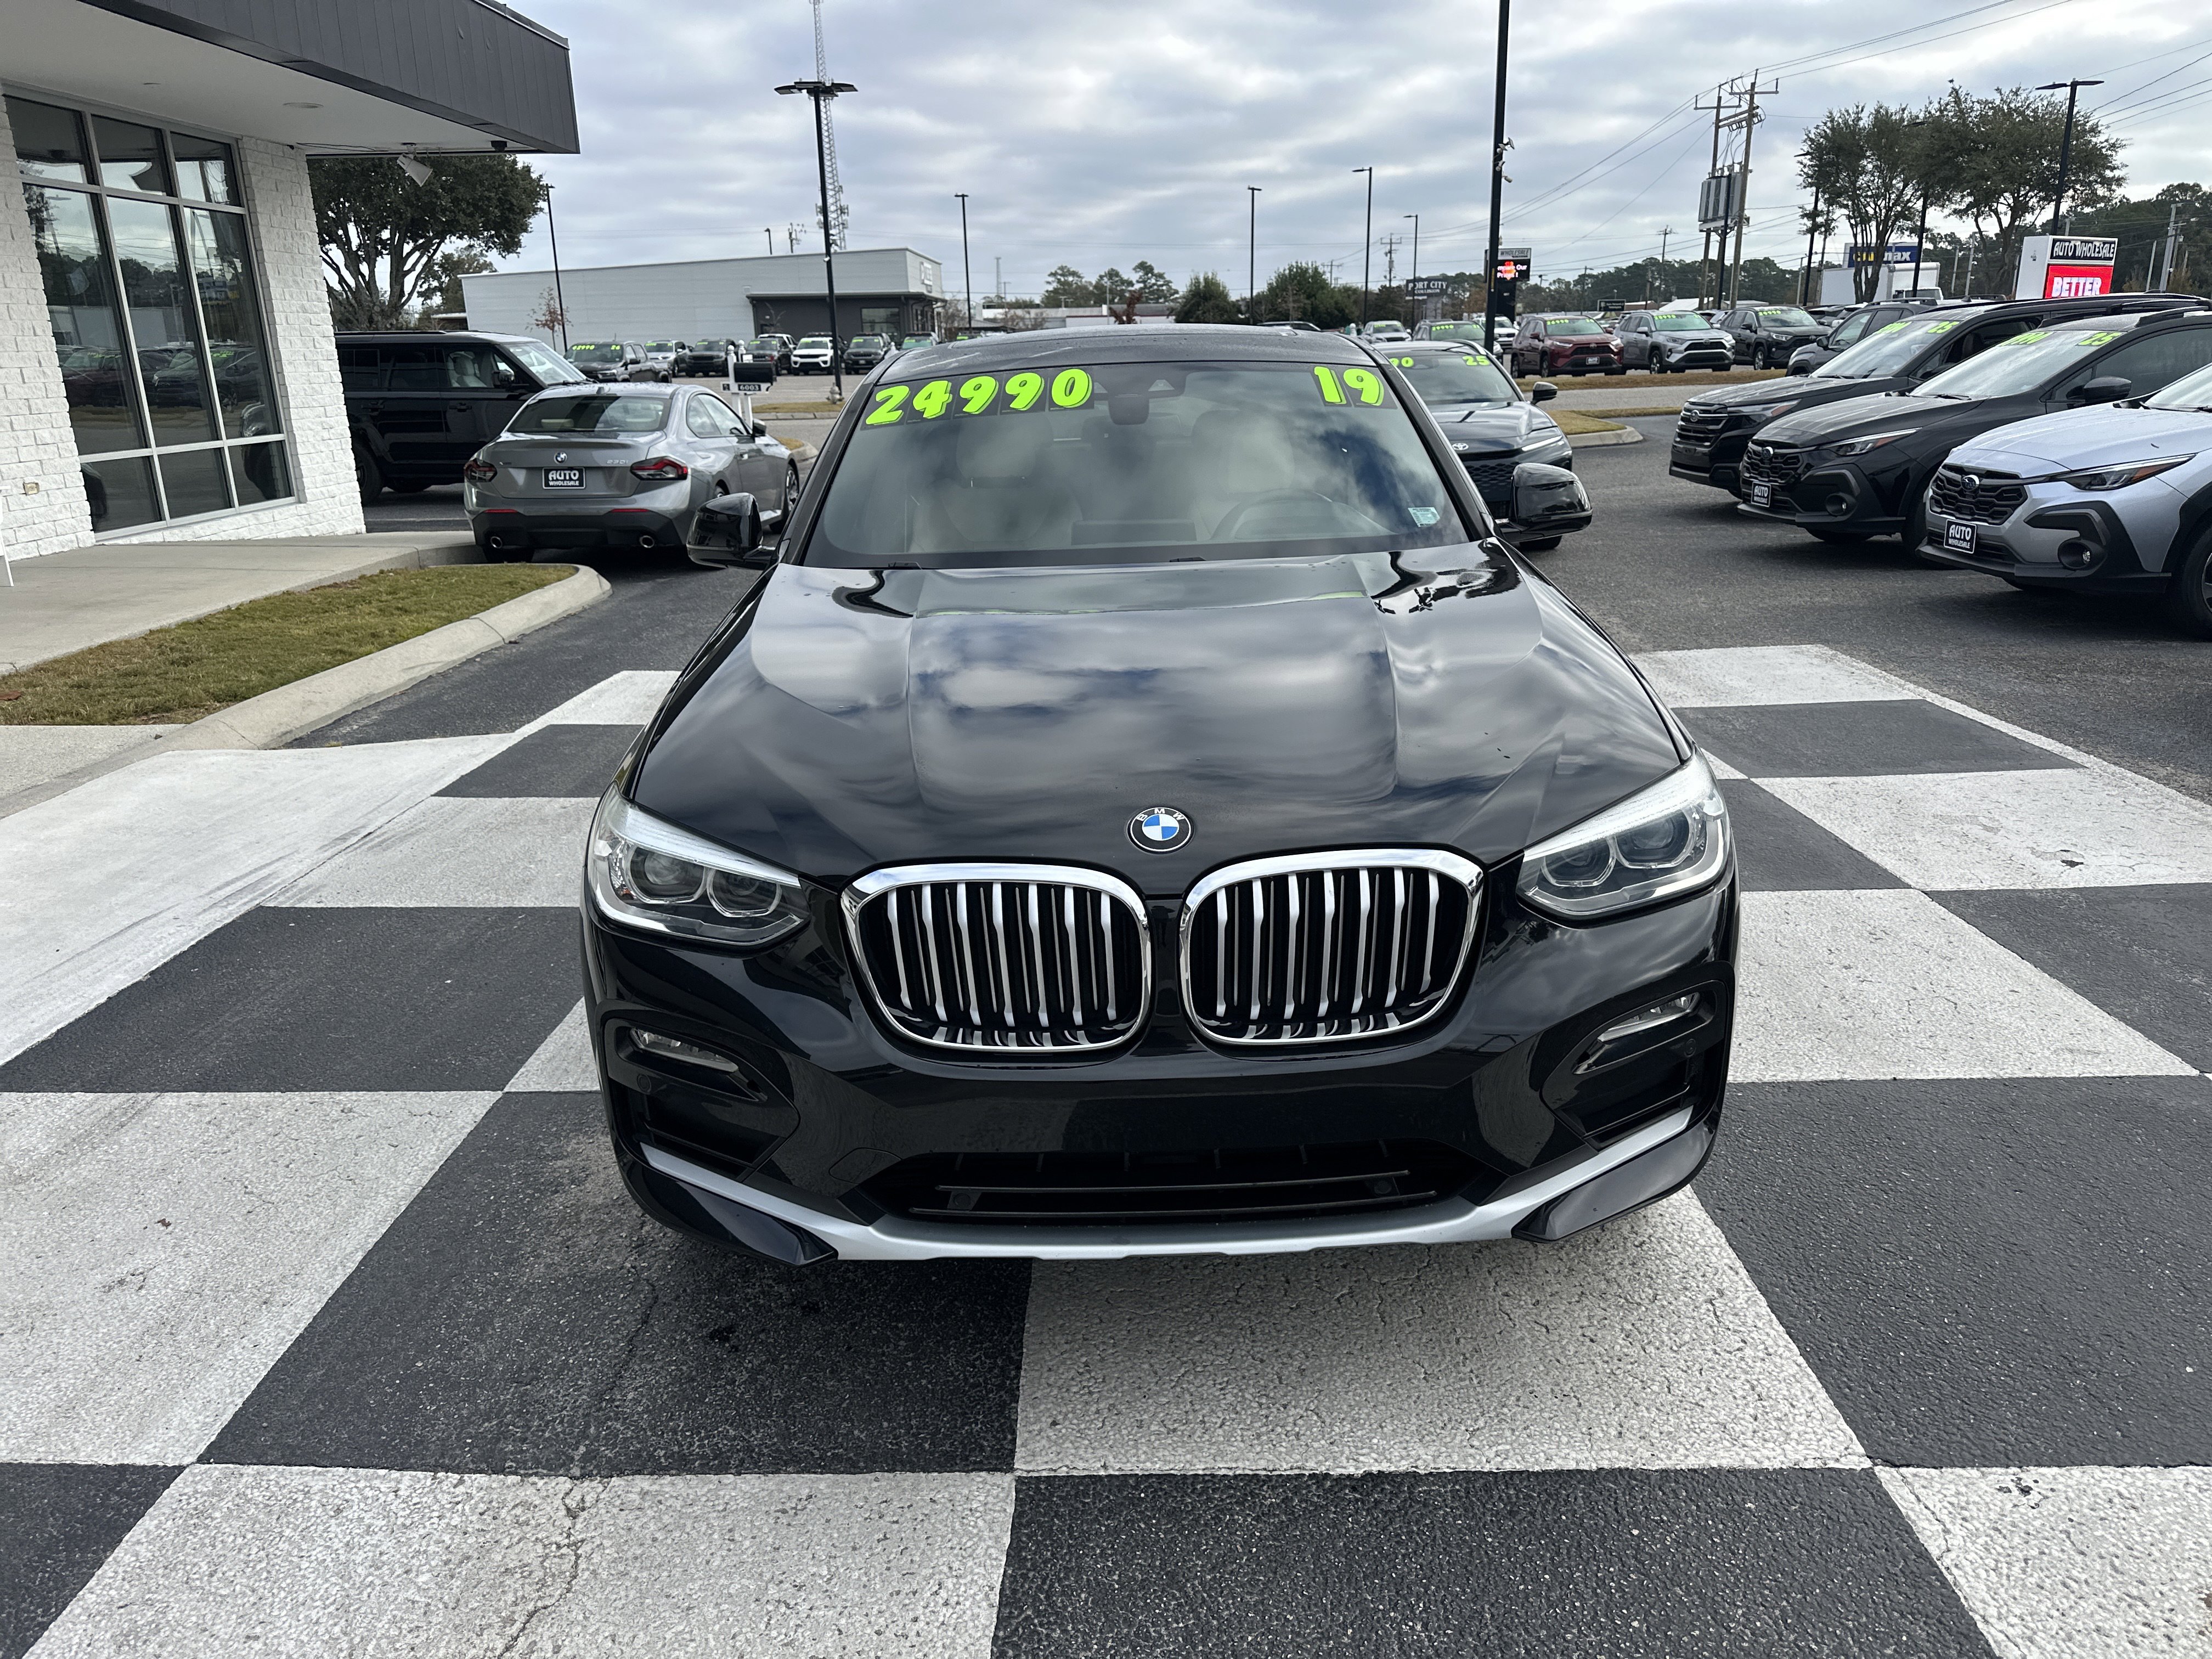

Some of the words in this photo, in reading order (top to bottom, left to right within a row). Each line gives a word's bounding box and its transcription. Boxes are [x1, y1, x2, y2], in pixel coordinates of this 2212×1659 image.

[2053, 241, 2074, 257] AUTO
[2075, 241, 2114, 258] WHOLESALE
[1408, 281, 1428, 291] PORT
[1430, 280, 1448, 289] CITY
[2051, 276, 2102, 297] BETTER
[1927, 321, 1960, 334] 25
[2078, 332, 2123, 346] 25
[1463, 356, 1491, 366] 25
[865, 368, 1093, 425] 24990
[1314, 366, 1384, 407] 19
[549, 470, 579, 481] AUTO
[1754, 486, 1768, 497] AUTO
[1949, 524, 1972, 540] AUTO
[1949, 538, 1971, 549] WHOLESALE
[1136, 808, 1185, 822] BMW
